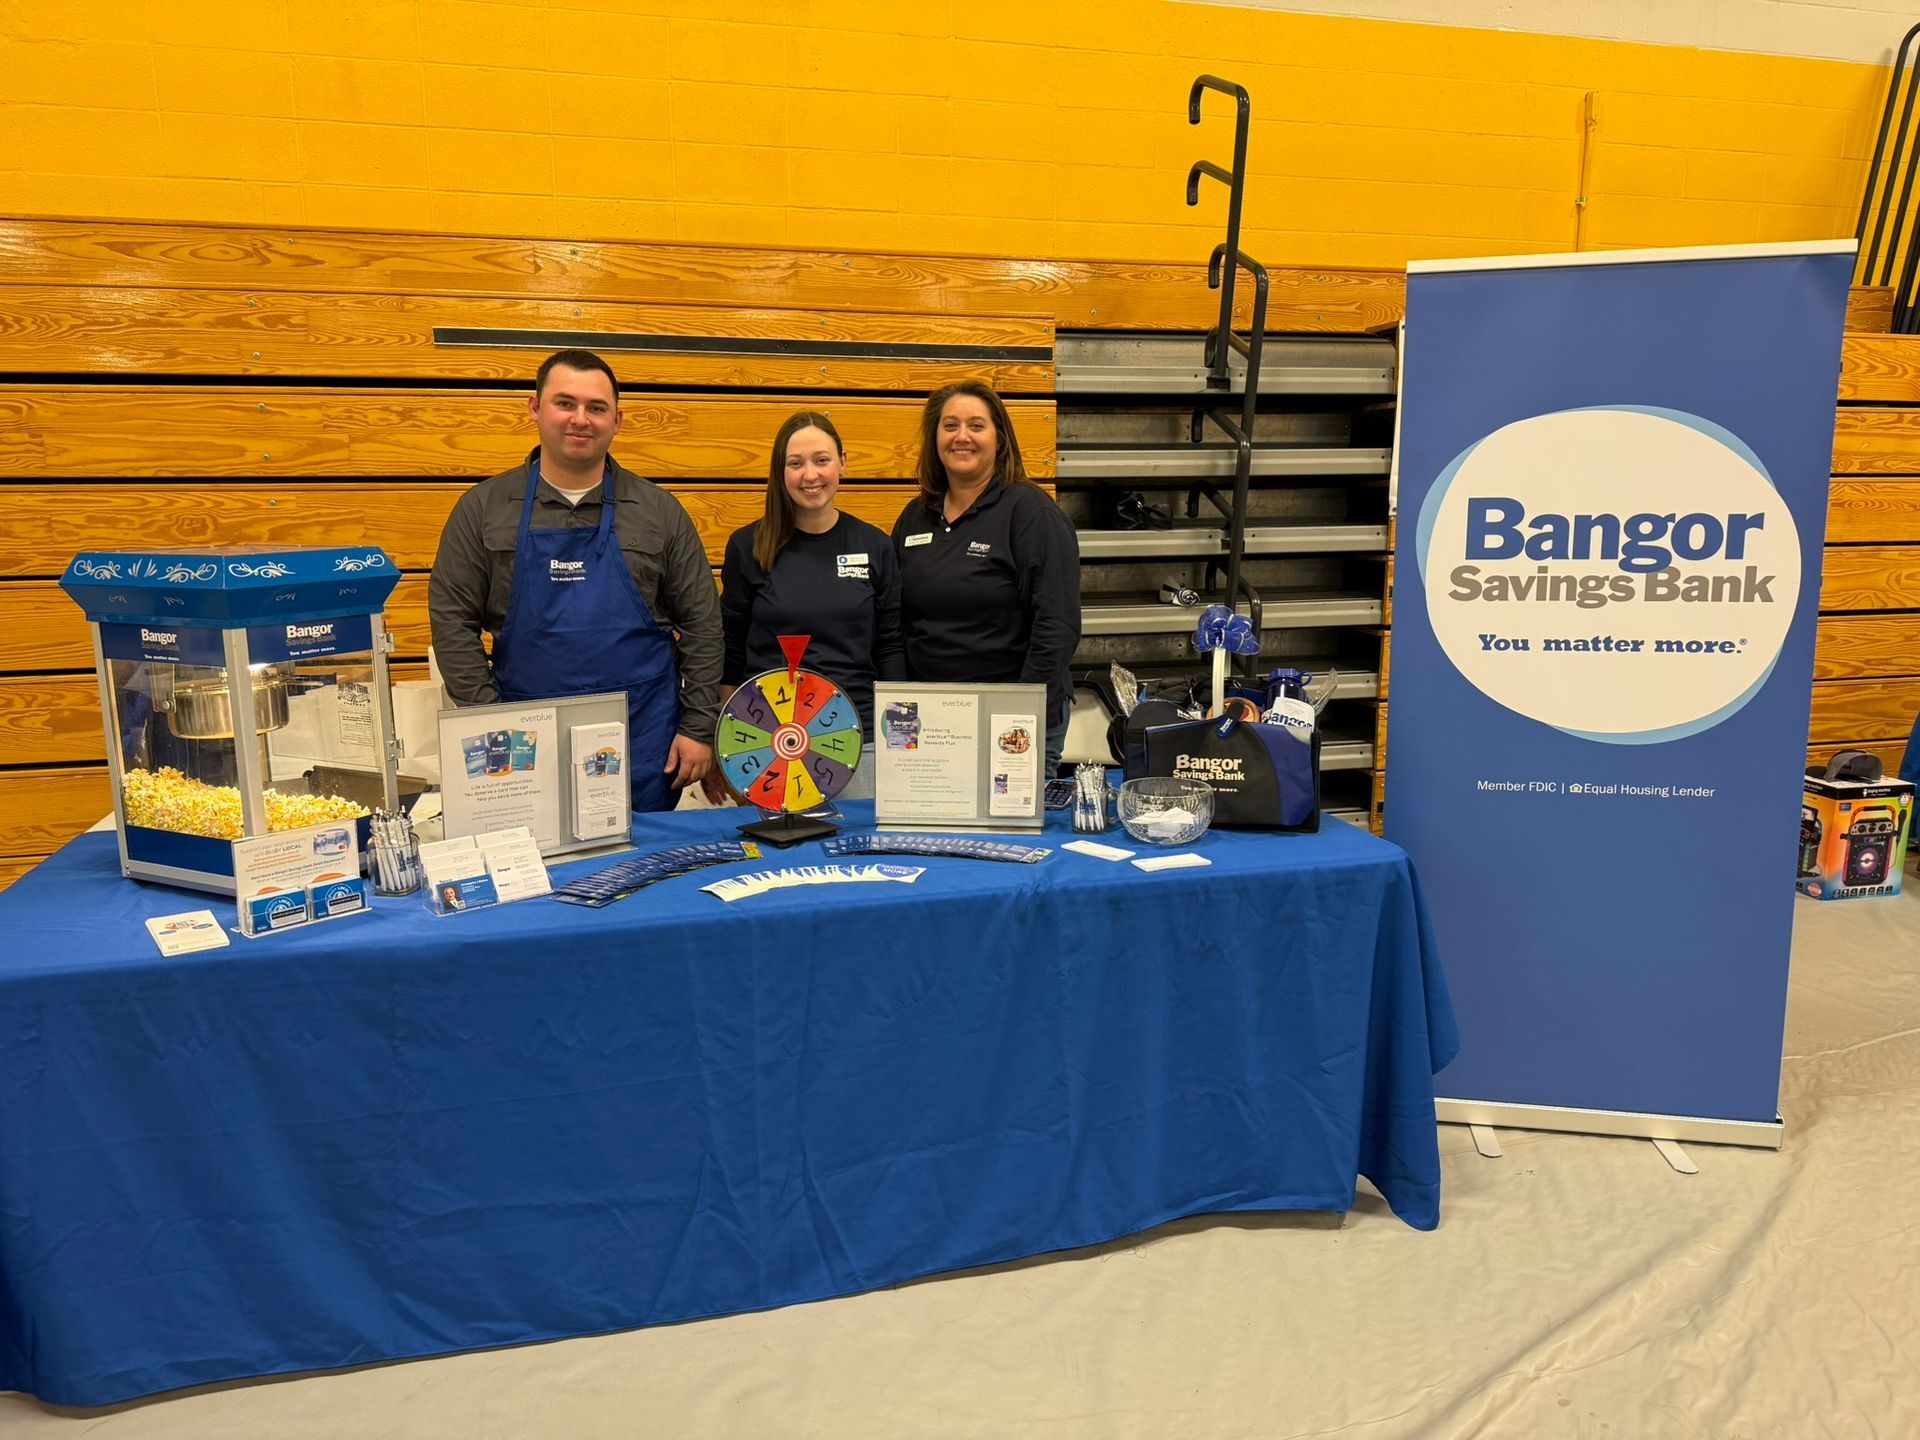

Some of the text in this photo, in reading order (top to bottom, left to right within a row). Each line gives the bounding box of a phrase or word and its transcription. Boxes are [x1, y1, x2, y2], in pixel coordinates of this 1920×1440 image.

[1465, 497, 1765, 573] Bangor
[970, 541, 991, 550] Bangor
[550, 559, 584, 570] Bangor
[837, 566, 869, 576] Bangor
[1448, 565, 1777, 609] Savings Bank
[141, 628, 177, 645] Bangor
[286, 623, 334, 638] Bangor
[285, 634, 337, 647] Savings Bank
[1478, 634, 1530, 652] You
[1543, 635, 1645, 653] matter
[775, 686, 791, 705] 1
[803, 692, 815, 708] 2
[520, 713, 553, 722] everblue
[746, 698, 764, 724] 5
[819, 711, 838, 728] 3
[735, 730, 757, 744] 4
[821, 738, 845, 752] 4
[741, 755, 761, 775] 3
[814, 757, 834, 786] 5
[1176, 754, 1242, 773] Bangor
[762, 769, 780, 793] 2
[1173, 769, 1245, 781] Savings Bank
[792, 774, 803, 798] 1
[1477, 780, 1526, 792] Member
[1529, 781, 1557, 792] FDIC
[1584, 783, 1618, 794] Equal
[1620, 784, 1670, 798] Housing
[1672, 785, 1716, 798] Lender
